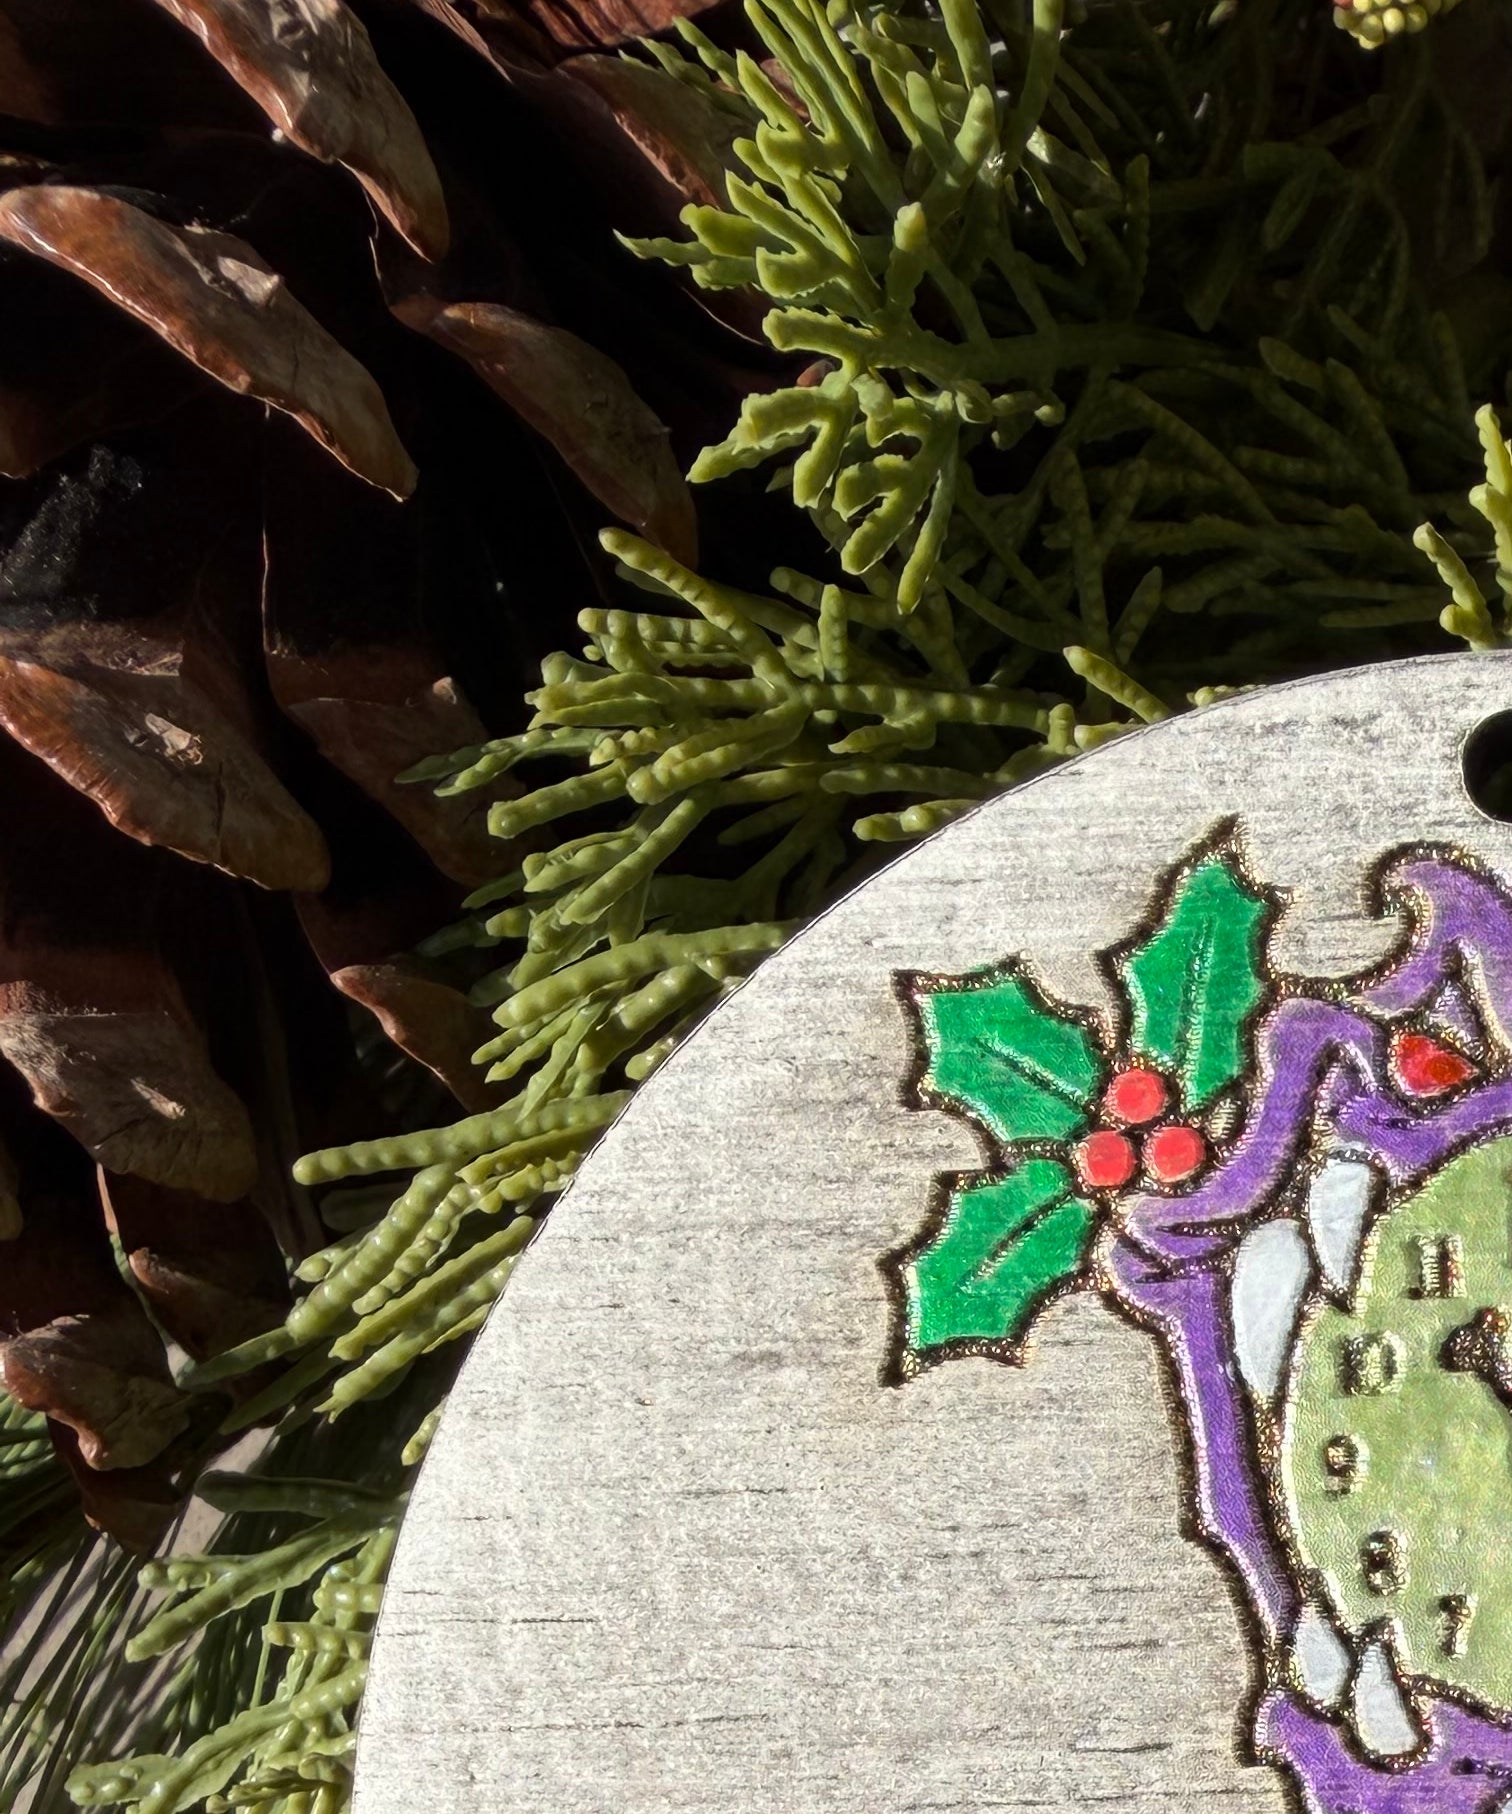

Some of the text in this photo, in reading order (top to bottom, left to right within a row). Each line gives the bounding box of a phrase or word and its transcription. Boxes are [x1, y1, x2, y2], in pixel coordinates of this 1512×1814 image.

[1406, 1233, 1467, 1300] 11
[1323, 1433, 1369, 1497] 9
[1361, 1527, 1411, 1596] 8
[1439, 1593, 1478, 1660] 7
